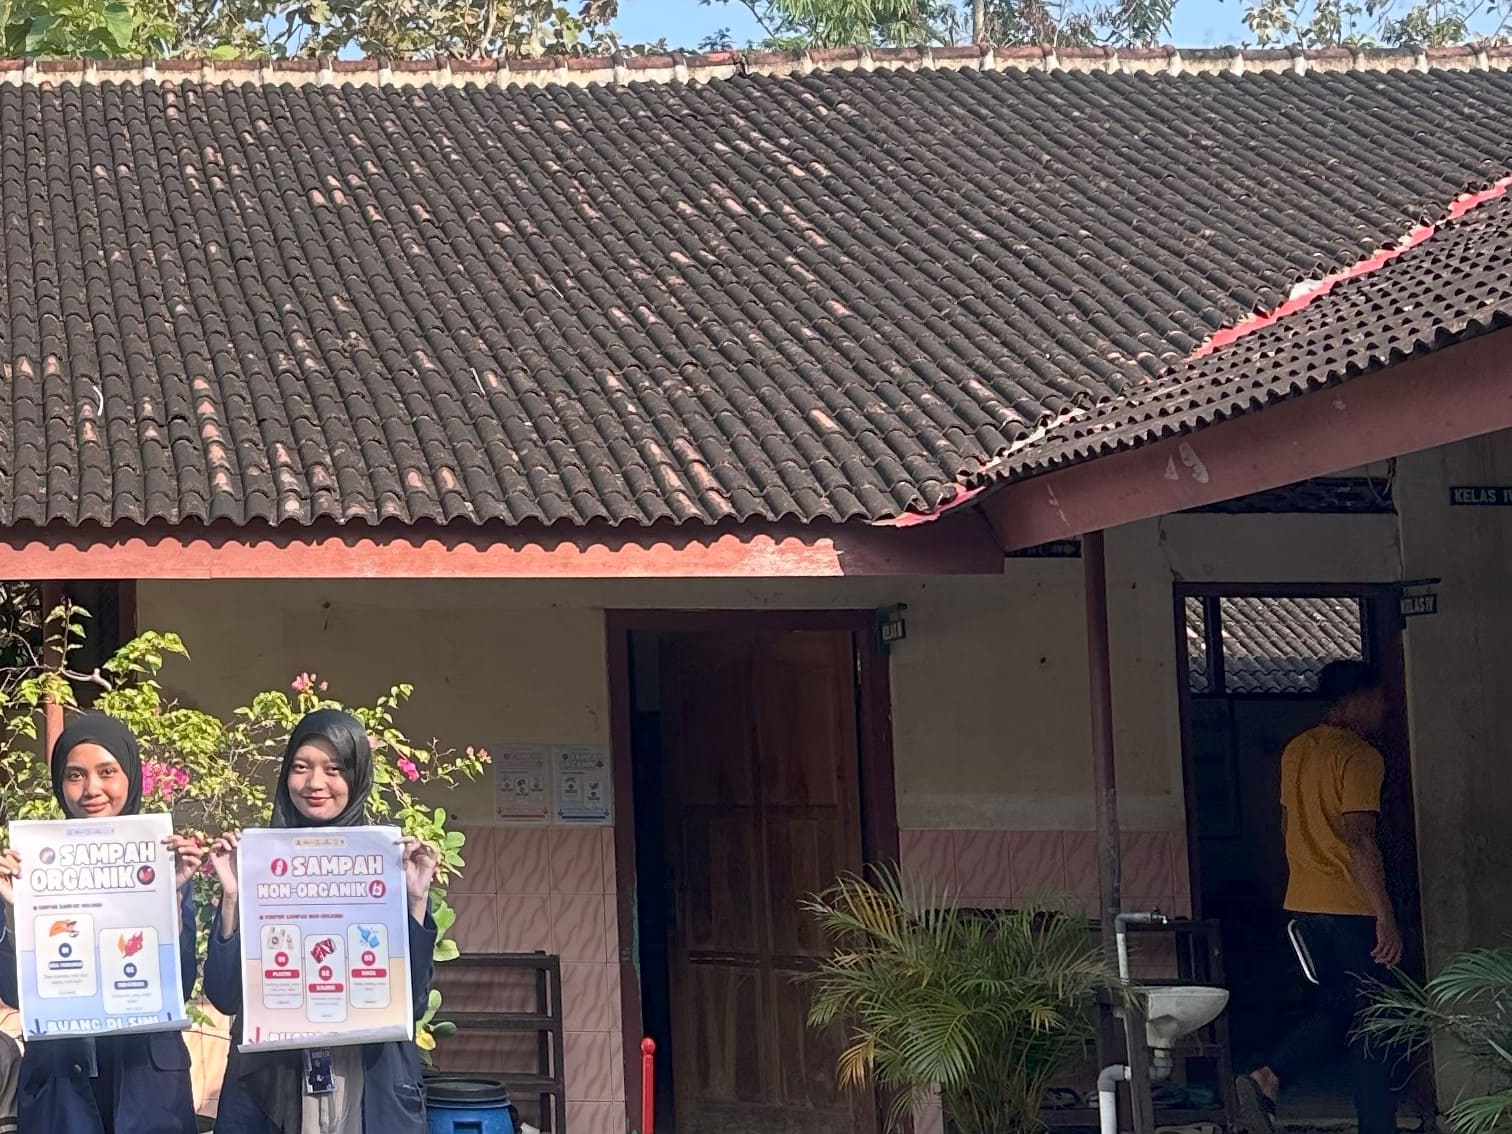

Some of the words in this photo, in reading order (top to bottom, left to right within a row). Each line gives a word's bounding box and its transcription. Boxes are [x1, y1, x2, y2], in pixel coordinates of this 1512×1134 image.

[1454, 489, 1496, 503] KELAS
[59, 841, 156, 866] SAMPAH
[291, 854, 384, 877] SAMPAH
[30, 865, 136, 892] ORGANIK
[257, 881, 368, 899] NON-ORGANIK
